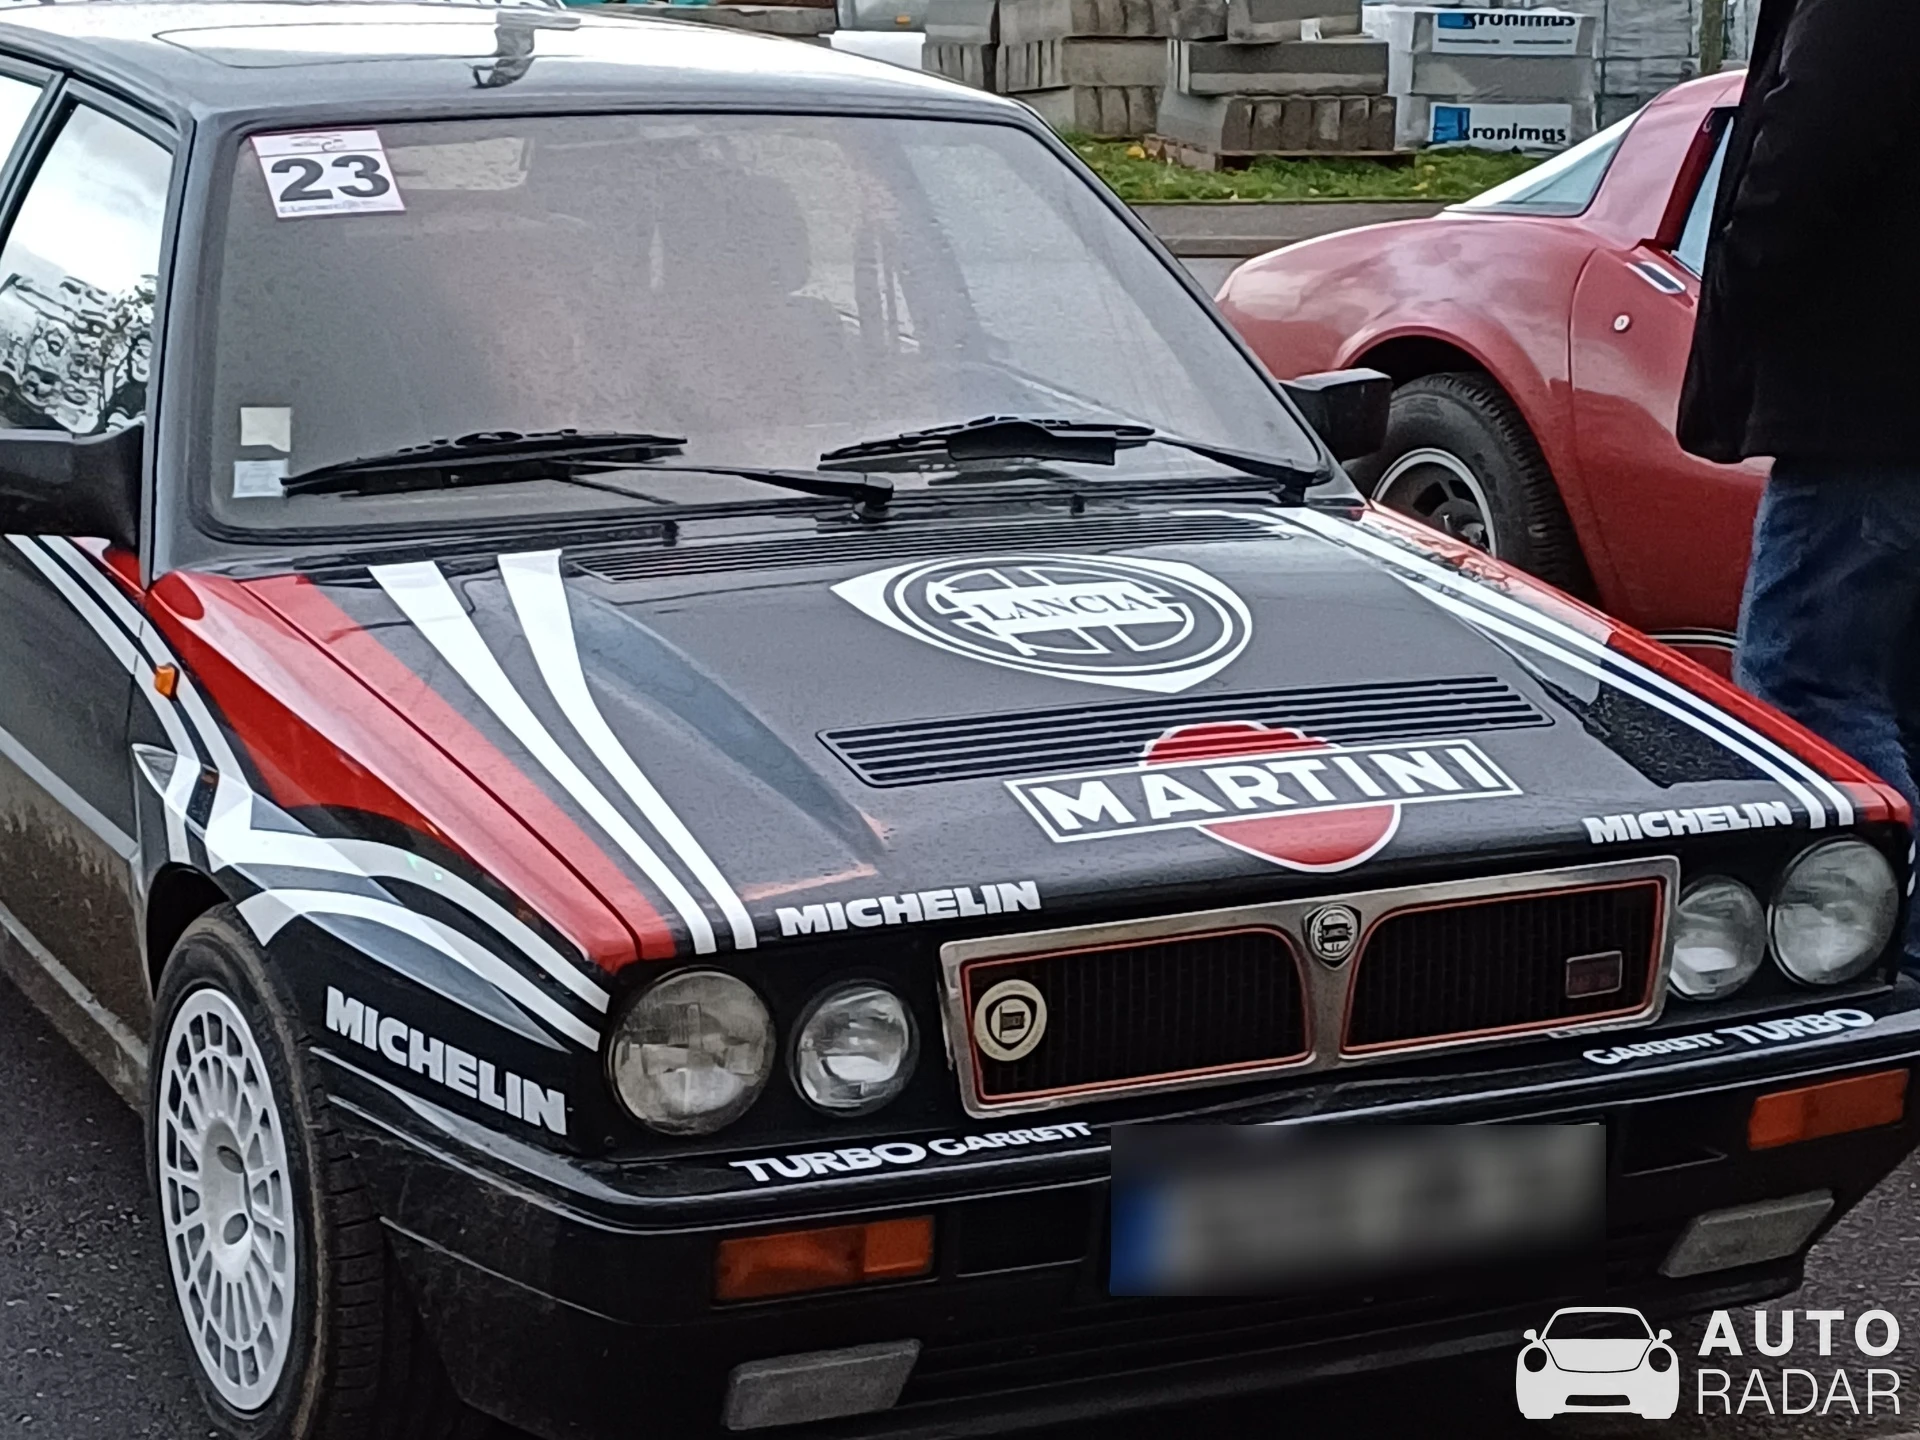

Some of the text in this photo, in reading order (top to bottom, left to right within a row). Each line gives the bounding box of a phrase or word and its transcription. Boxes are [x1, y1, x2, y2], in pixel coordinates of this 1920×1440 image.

[271, 154, 390, 202] 23
[972, 592, 1159, 621] LANCIA
[1029, 747, 1503, 831] MARTINI
[1582, 801, 1793, 844] MICHELIN
[775, 880, 1041, 937] MICHELIN
[326, 985, 568, 1136] MICHELIN
[1582, 1008, 1876, 1066] GARRETT TURBO
[728, 1121, 1093, 1182] TURBO GARRETT
